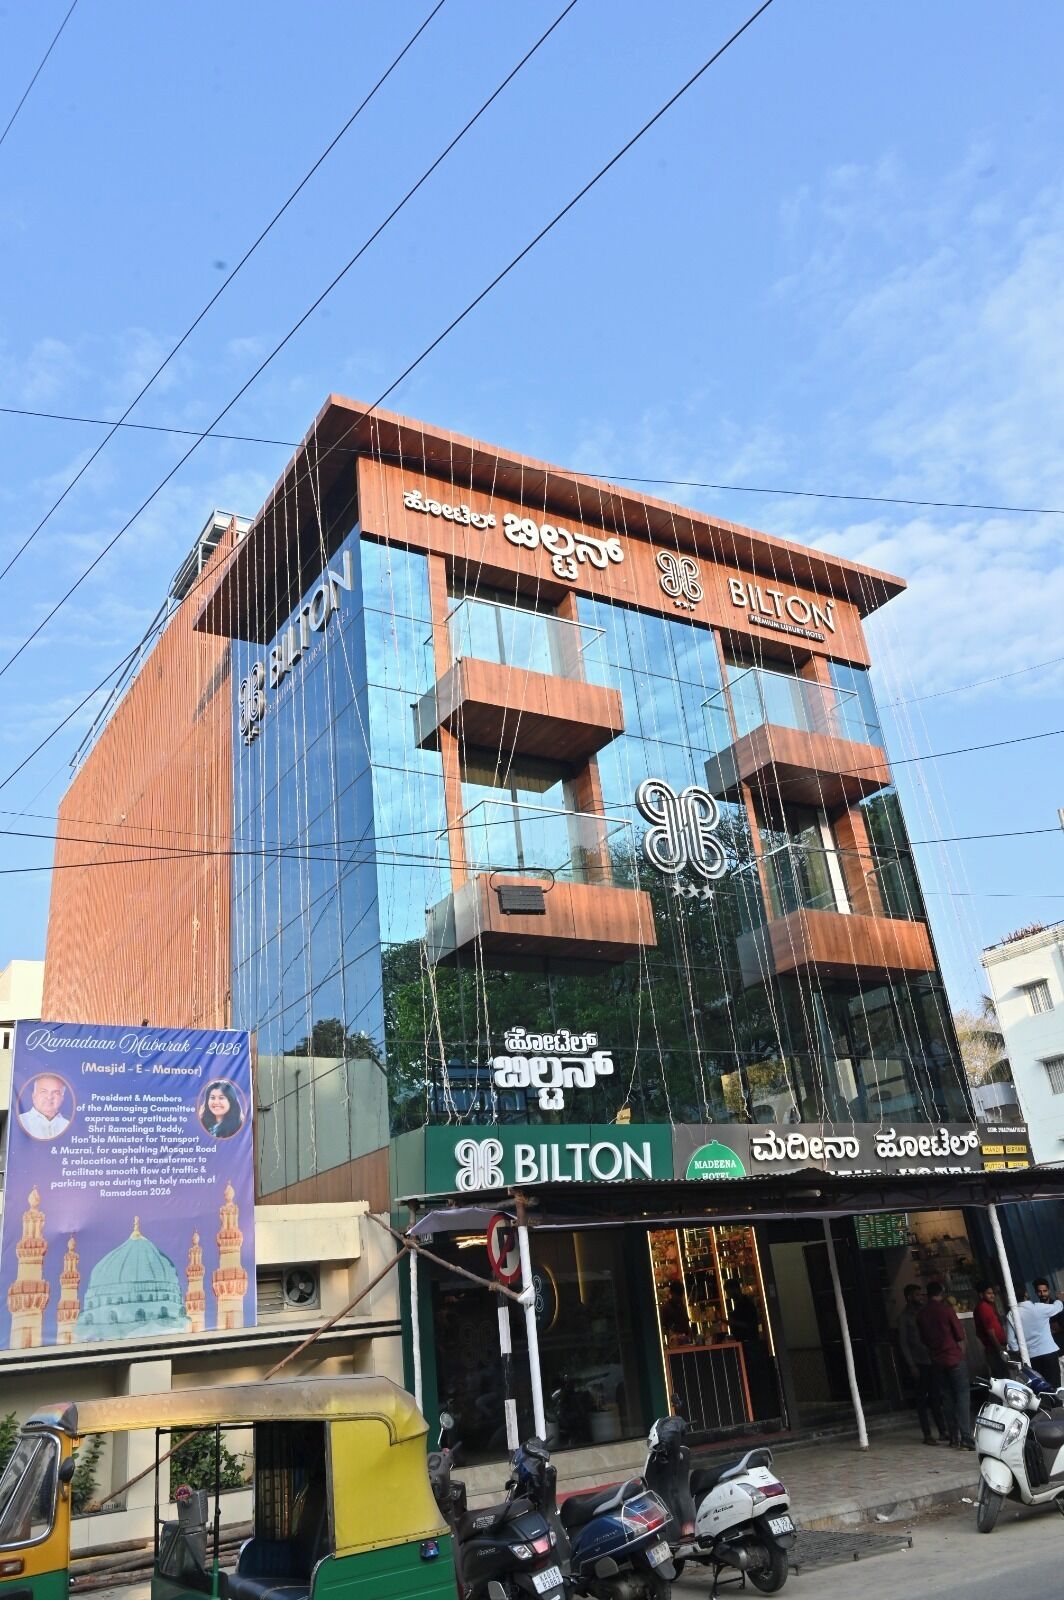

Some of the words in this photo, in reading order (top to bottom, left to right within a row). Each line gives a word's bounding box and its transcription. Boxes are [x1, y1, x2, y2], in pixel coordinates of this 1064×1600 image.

[403, 490, 496, 529] ಹೋಟೆಲ್
[269, 550, 353, 690] BILTON
[750, 614, 780, 628] PREMIUM
[780, 622, 804, 635] LUXURY
[805, 630, 825, 640] HOTEL
[26, 1028, 117, 1053] Ramadaan
[118, 1033, 191, 1058] Mubarak
[206, 1041, 242, 1056] 2026
[505, 1026, 599, 1054] ಹೋಟೆಲ್
[81, 1061, 126, 1075] (Masjid
[152, 1065, 202, 1077] Mamoor)
[493, 1050, 615, 1110] ಬಿಲ್ಟನ್
[91, 1093, 133, 1102] President
[135, 1094, 141, 1102] &
[143, 1094, 183, 1102] Members
[76, 1103, 86, 1111] of
[103, 1104, 148, 1114] Managing
[150, 1104, 196, 1112] Committee
[84, 1116, 120, 1125] express
[138, 1114, 178, 1124] gratitude
[88, 1124, 106, 1133] Shri
[108, 1124, 155, 1135] Ramalinga
[156, 1125, 185, 1135] Reddy,
[107, 1135, 144, 1143] Minister
[145, 1135, 158, 1143] for
[159, 1135, 200, 1144] Transport
[875, 1127, 979, 1158] ಹೋಟೆಲ್
[50, 1146, 58, 1154] &
[60, 1146, 94, 1155] Muzrai,
[96, 1146, 110, 1154] for
[111, 1145, 158, 1155] asphalting
[160, 1145, 194, 1155] Mosque
[195, 1145, 217, 1153] Road
[62, 1157, 69, 1165] &
[70, 1156, 117, 1165] relocation
[119, 1156, 128, 1164] of
[129, 1156, 144, 1164] the
[146, 1155, 197, 1164] transformer
[514, 1141, 653, 1183] BILTON
[694, 1159, 737, 1169] MADEENA
[62, 1167, 104, 1176] facilitate
[105, 1167, 139, 1175] smooth
[140, 1166, 159, 1174] flow
[161, 1165, 171, 1174] of
[172, 1165, 199, 1174] traffic
[200, 1165, 207, 1173] &
[50, 1179, 87, 1190] parking
[112, 1177, 142, 1188] during
[143, 1177, 158, 1185] the
[159, 1176, 177, 1186] holy
[179, 1175, 206, 1184] month
[207, 1175, 216, 1183] of
[100, 1188, 148, 1197] Ramadaan
[150, 1187, 171, 1196] 2026
